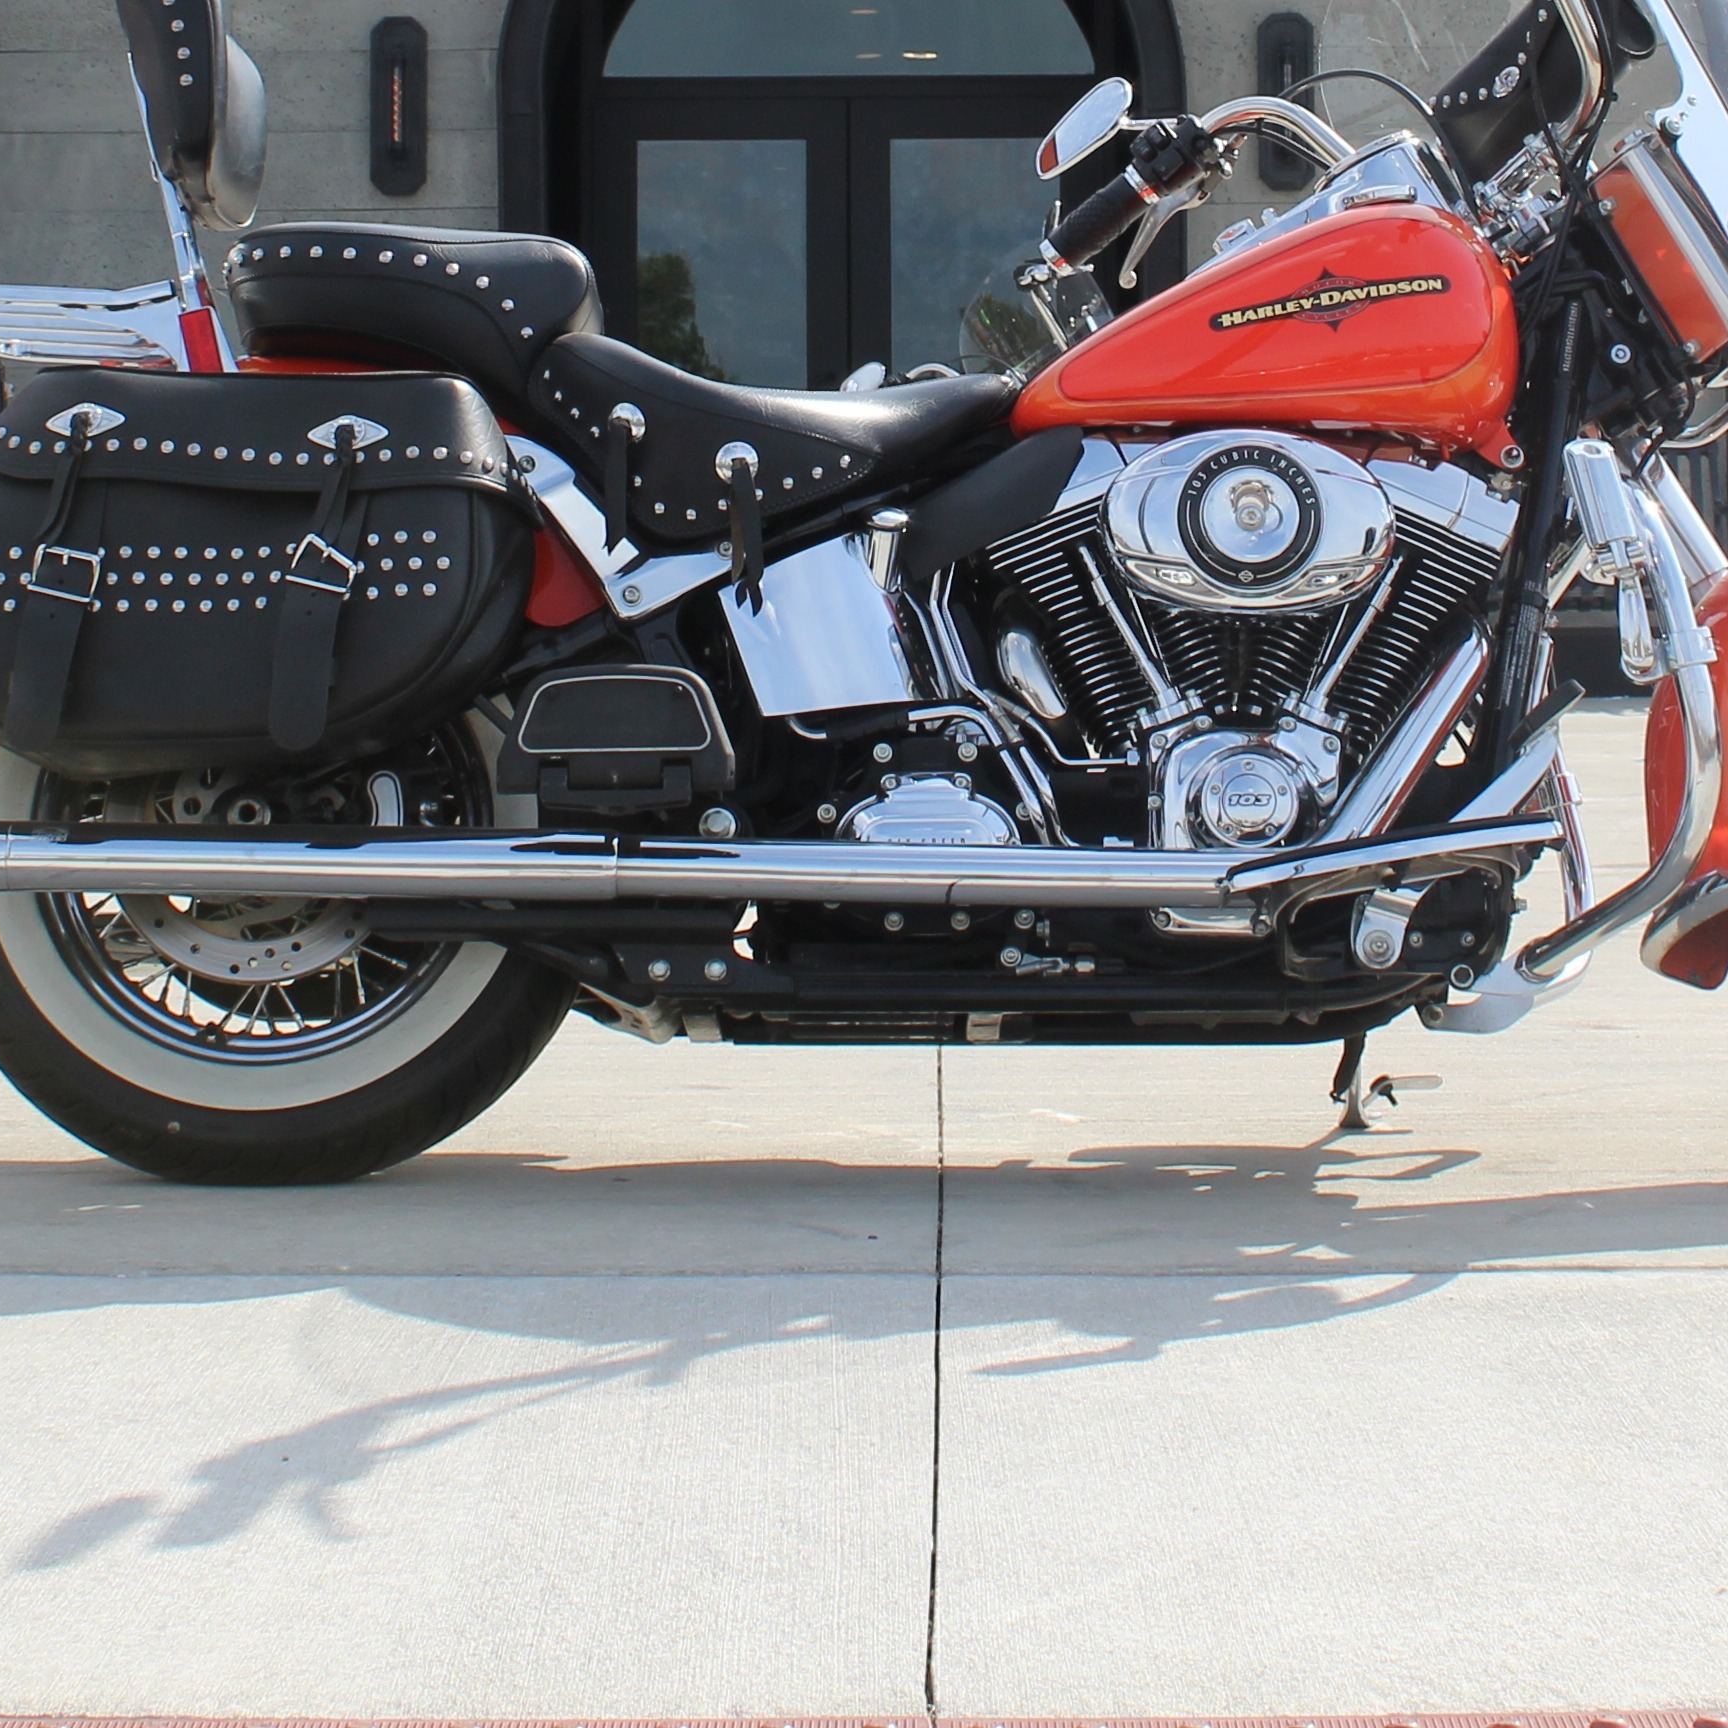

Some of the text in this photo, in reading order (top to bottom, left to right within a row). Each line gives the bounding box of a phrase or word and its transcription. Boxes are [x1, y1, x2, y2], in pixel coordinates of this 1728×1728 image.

[1217, 278, 1443, 328] HARLEY-DAVIDSON
[1187, 449, 1316, 505] 103 CUBIC INCHES
[1227, 793, 1272, 807] 103
